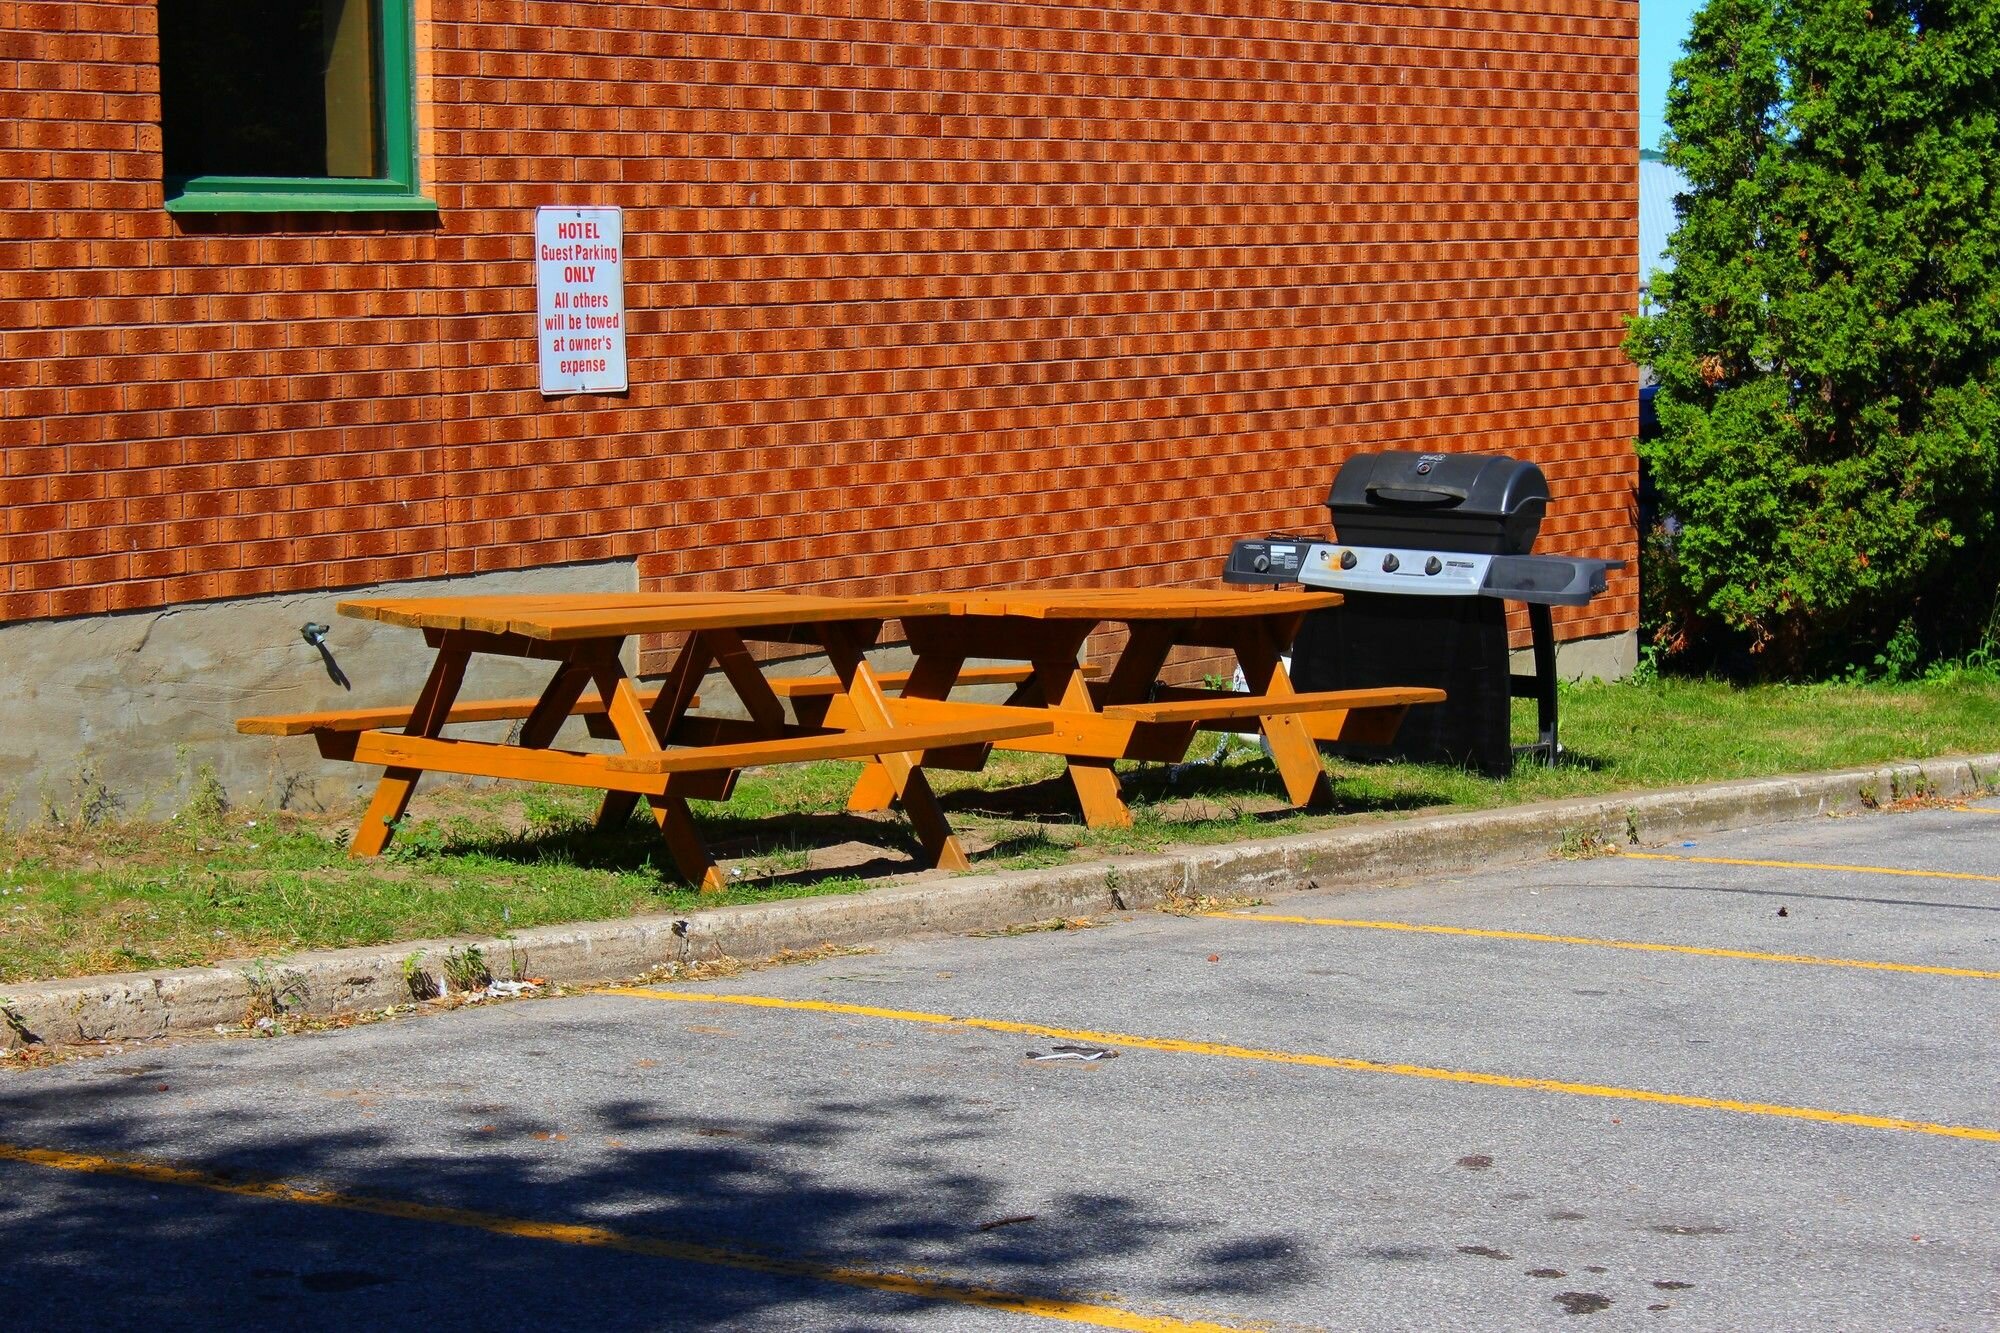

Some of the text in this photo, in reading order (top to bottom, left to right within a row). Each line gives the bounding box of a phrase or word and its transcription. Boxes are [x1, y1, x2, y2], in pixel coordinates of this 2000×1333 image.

[558, 222, 600, 239] HOTEL
[541, 244, 617, 264] Guest Parking
[564, 266, 596, 283] ONLY
[554, 292, 608, 308] All others
[545, 313, 618, 330] will be towed
[554, 336, 612, 352] at owner's
[560, 359, 606, 376] expense
